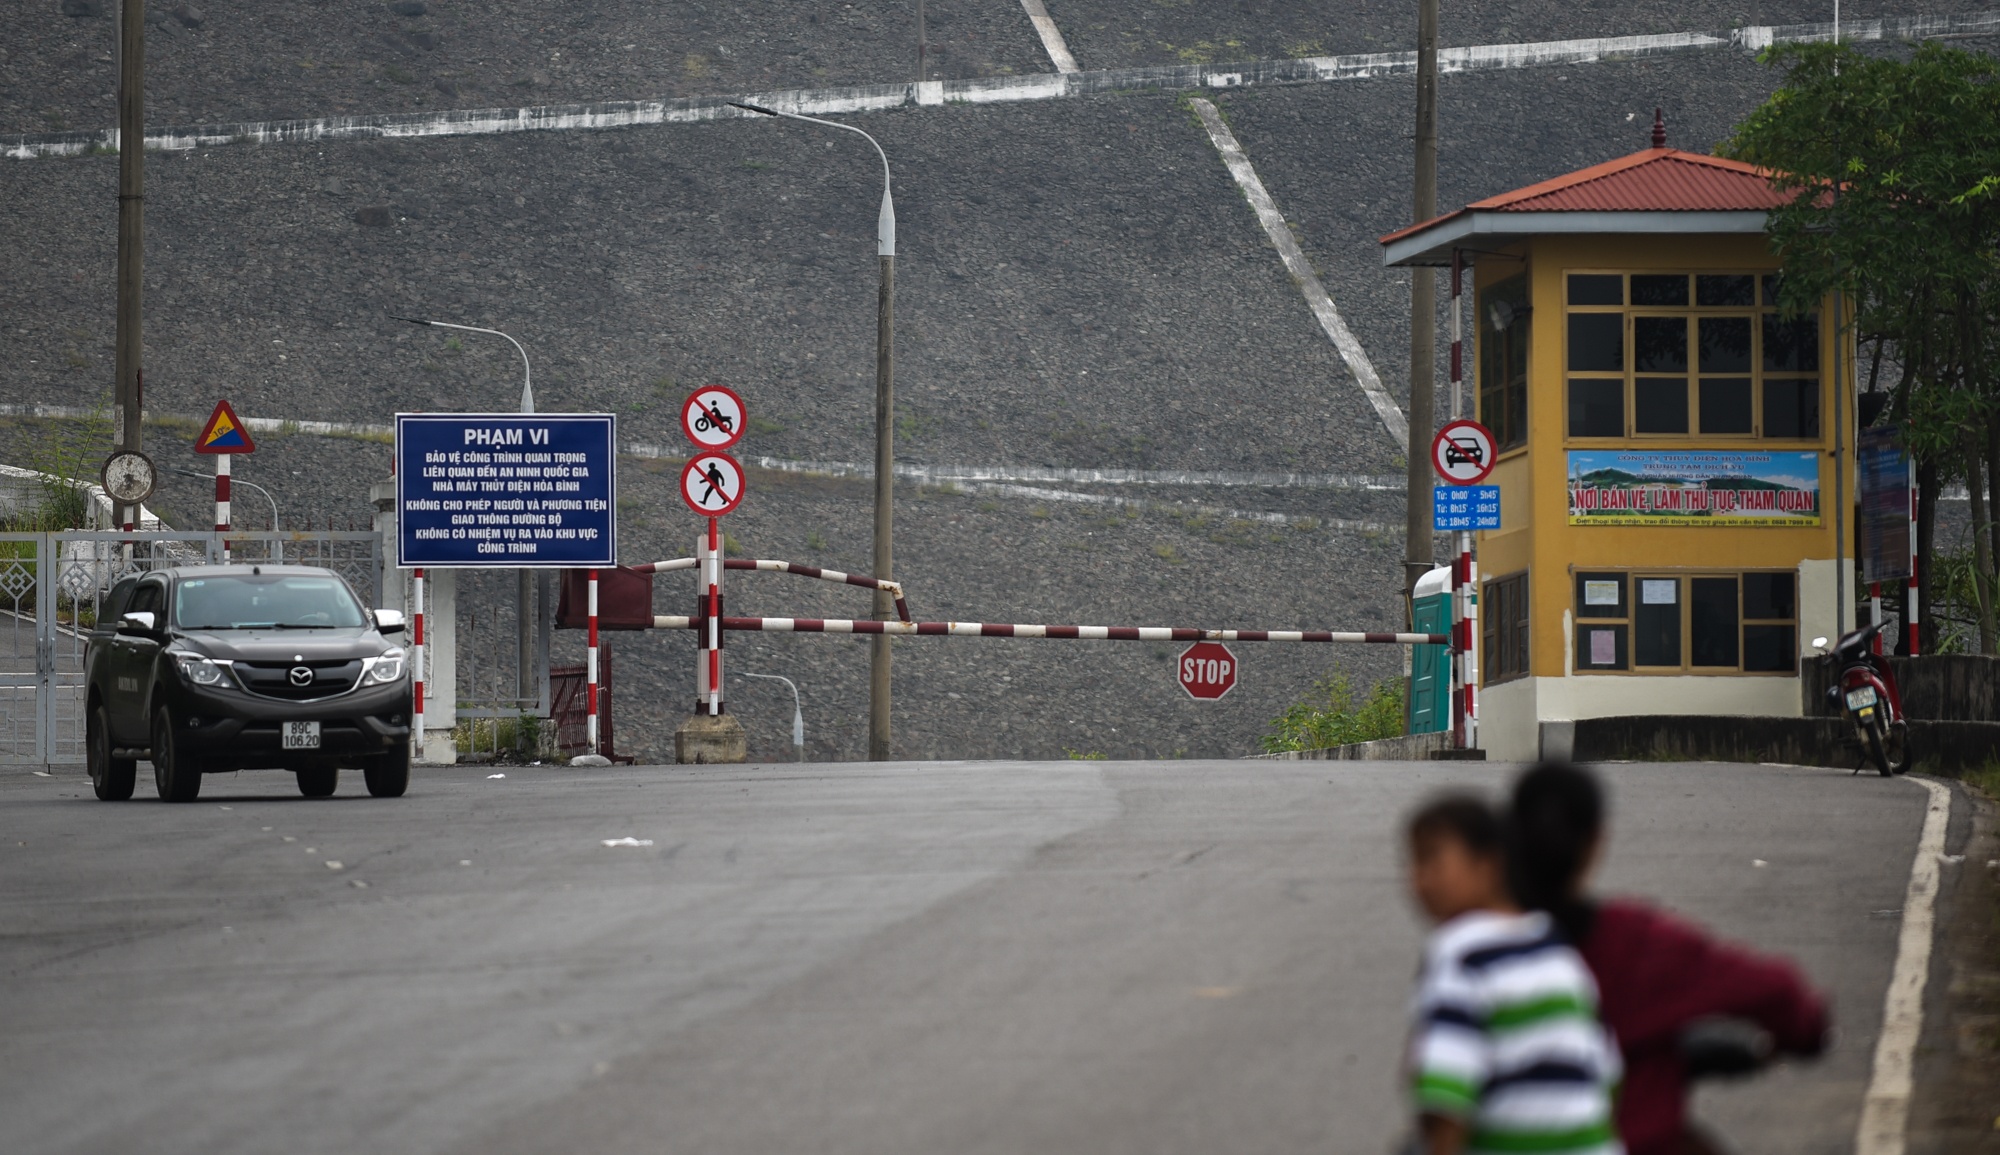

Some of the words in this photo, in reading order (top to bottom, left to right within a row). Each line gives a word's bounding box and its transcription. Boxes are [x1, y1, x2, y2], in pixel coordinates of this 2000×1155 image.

[213, 424, 230, 438] 10%
[464, 428, 523, 450] PHẠM
[528, 428, 549, 445] VI
[426, 450, 446, 463] BẢO
[448, 451, 461, 464] VỆ
[463, 451, 490, 463] CÔNG
[493, 451, 522, 463] TRÌNH
[525, 452, 551, 463] QUAN
[554, 452, 586, 464] TRỌNG
[423, 466, 446, 477] LIÊN
[448, 467, 474, 477] QUAN
[477, 464, 497, 477] ĐẾN
[500, 467, 515, 477] AN
[516, 467, 540, 477] NINH
[543, 464, 569, 477] QUỐC
[572, 467, 589, 477] GIA
[432, 480, 454, 492] NHÀ
[456, 480, 478, 492] MÁY
[480, 479, 505, 492] THỦY
[507, 480, 530, 493] ĐIỆN
[556, 480, 580, 492] BÌNH
[406, 499, 440, 510] KHÔNG
[443, 500, 463, 510] CHO
[466, 498, 492, 510] PHÉP
[494, 498, 524, 510] NGƯỜI
[526, 498, 539, 510] VÀ
[542, 499, 582, 510] PHƯƠNG
[584, 498, 607, 512] TIỆN
[1575, 487, 1598, 509] NƠI
[1601, 485, 1627, 509] BÁN
[1631, 486, 1651, 511] VÉ,
[1654, 486, 1680, 509] LÀM
[1685, 482, 1708, 510] THỦ
[1712, 490, 1736, 514] TỤC
[1739, 491, 1774, 510] THAM
[1778, 491, 1812, 512] QUAN
[452, 515, 475, 525] GIAO
[477, 513, 510, 525] THÔNG
[512, 513, 546, 525] ĐƯỜNG
[548, 513, 562, 526] BỘ
[416, 527, 450, 539] KHÔNG
[452, 527, 466, 539] CÓ
[468, 528, 501, 541] NHIỆM
[503, 529, 516, 541] VỤ
[518, 529, 532, 539] RA
[534, 527, 553, 539] VÀO
[556, 529, 576, 539] KHU
[578, 528, 598, 541] VỰC
[478, 542, 505, 553] CÔNG
[507, 542, 537, 553] TRÌNH
[1183, 658, 1230, 684] STOP
[291, 722, 311, 734] 89C
[285, 735, 320, 746] 106.20
